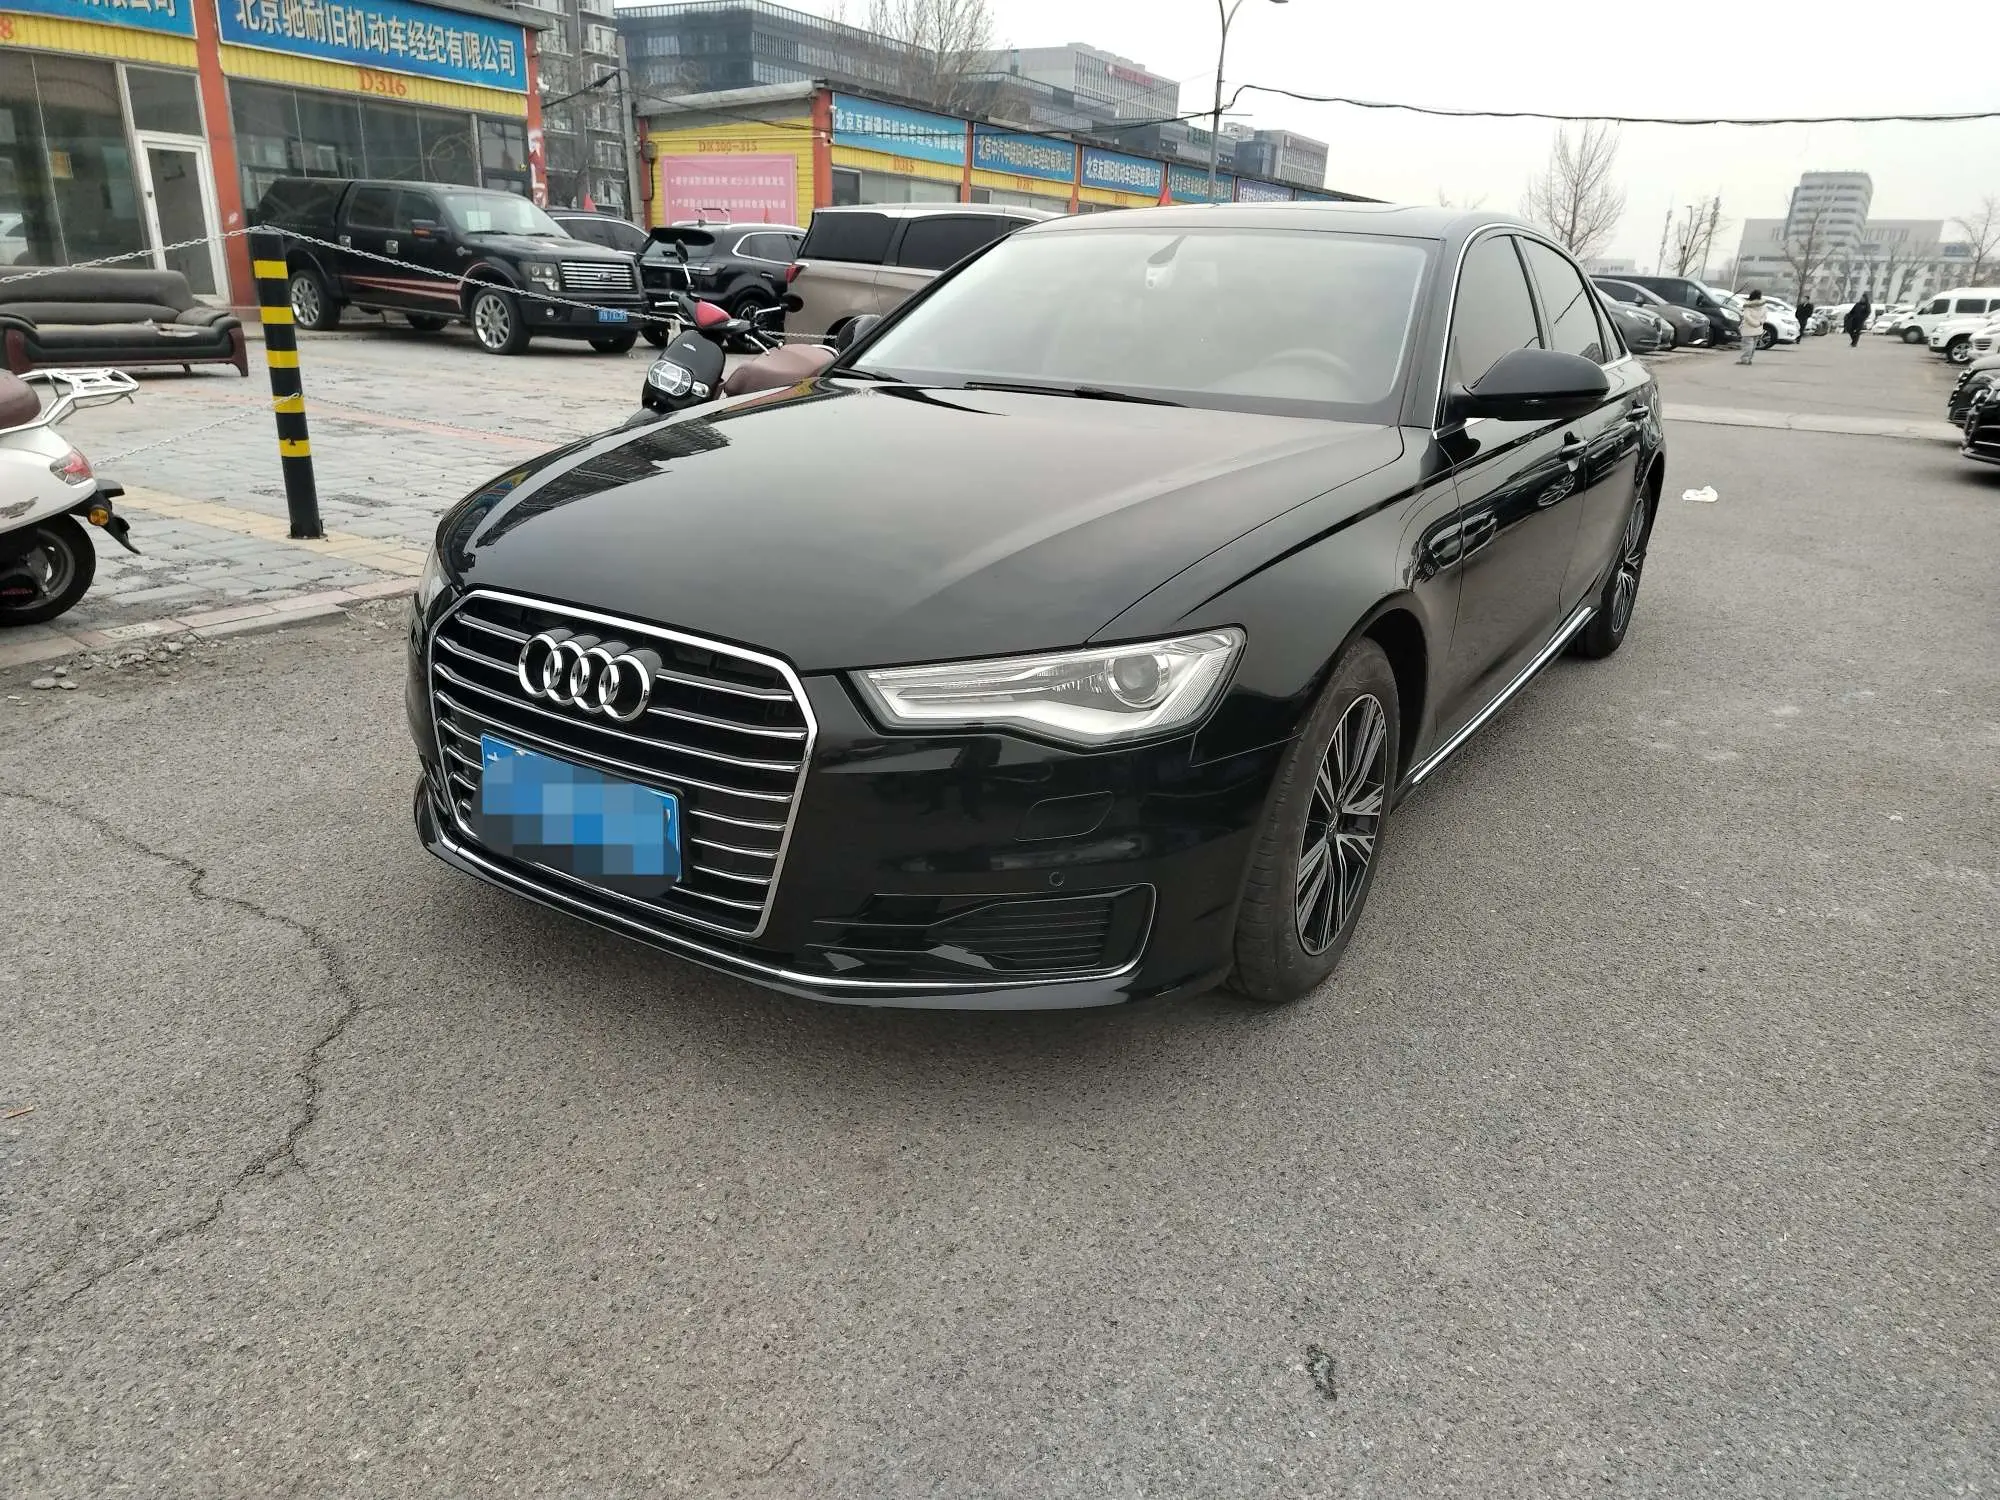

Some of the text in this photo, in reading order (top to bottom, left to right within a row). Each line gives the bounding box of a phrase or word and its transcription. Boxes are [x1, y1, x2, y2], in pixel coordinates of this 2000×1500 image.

[237, 0, 516, 77] 北京驰耐旧机动车经纪有限公司
[359, 71, 407, 97] D316
